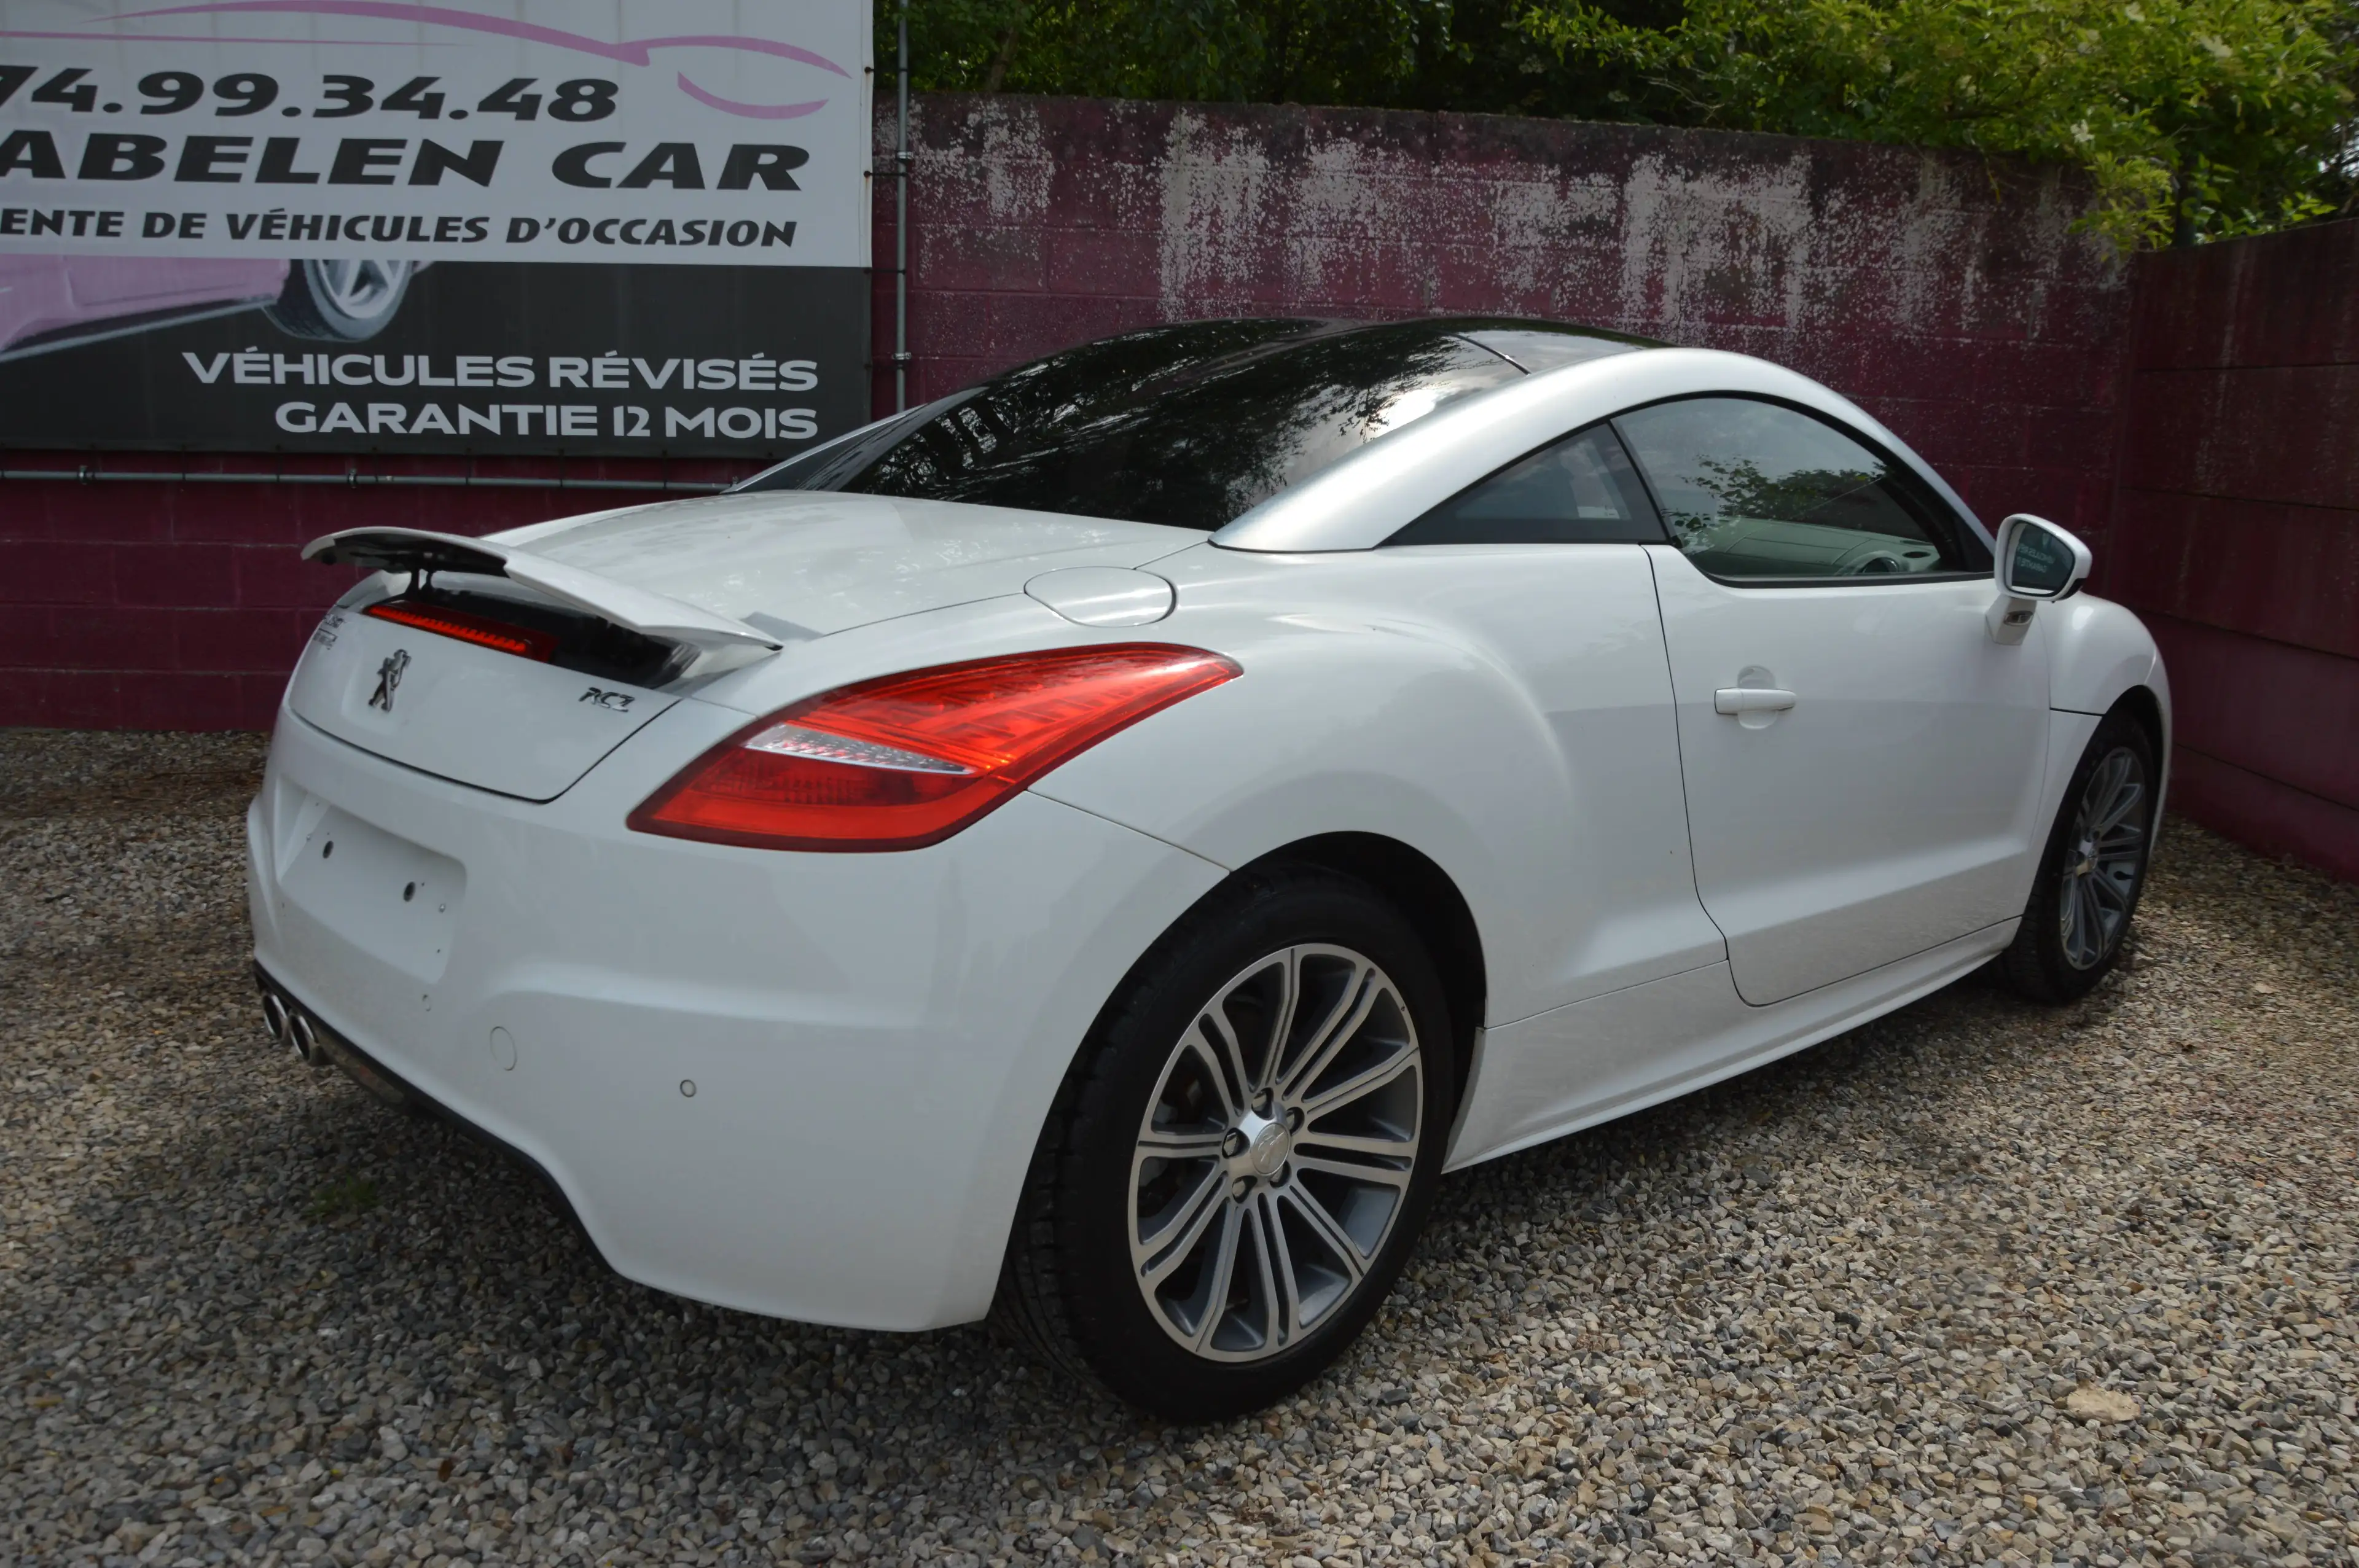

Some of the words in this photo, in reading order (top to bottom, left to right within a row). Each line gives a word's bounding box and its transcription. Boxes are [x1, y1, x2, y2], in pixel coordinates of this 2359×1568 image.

[0, 130, 504, 187] ABELEN
[552, 142, 809, 190] CAR
[143, 213, 206, 238] DE
[227, 208, 490, 243] VÉHICULES
[506, 217, 797, 247] D'OCCASION
[182, 346, 534, 387] VÉHICULES
[549, 351, 818, 391] RÉVISÉS
[276, 402, 597, 435] GARANTIE
[614, 406, 650, 436] 12
[665, 407, 818, 439] MOIS
[578, 687, 636, 712] RCZ
